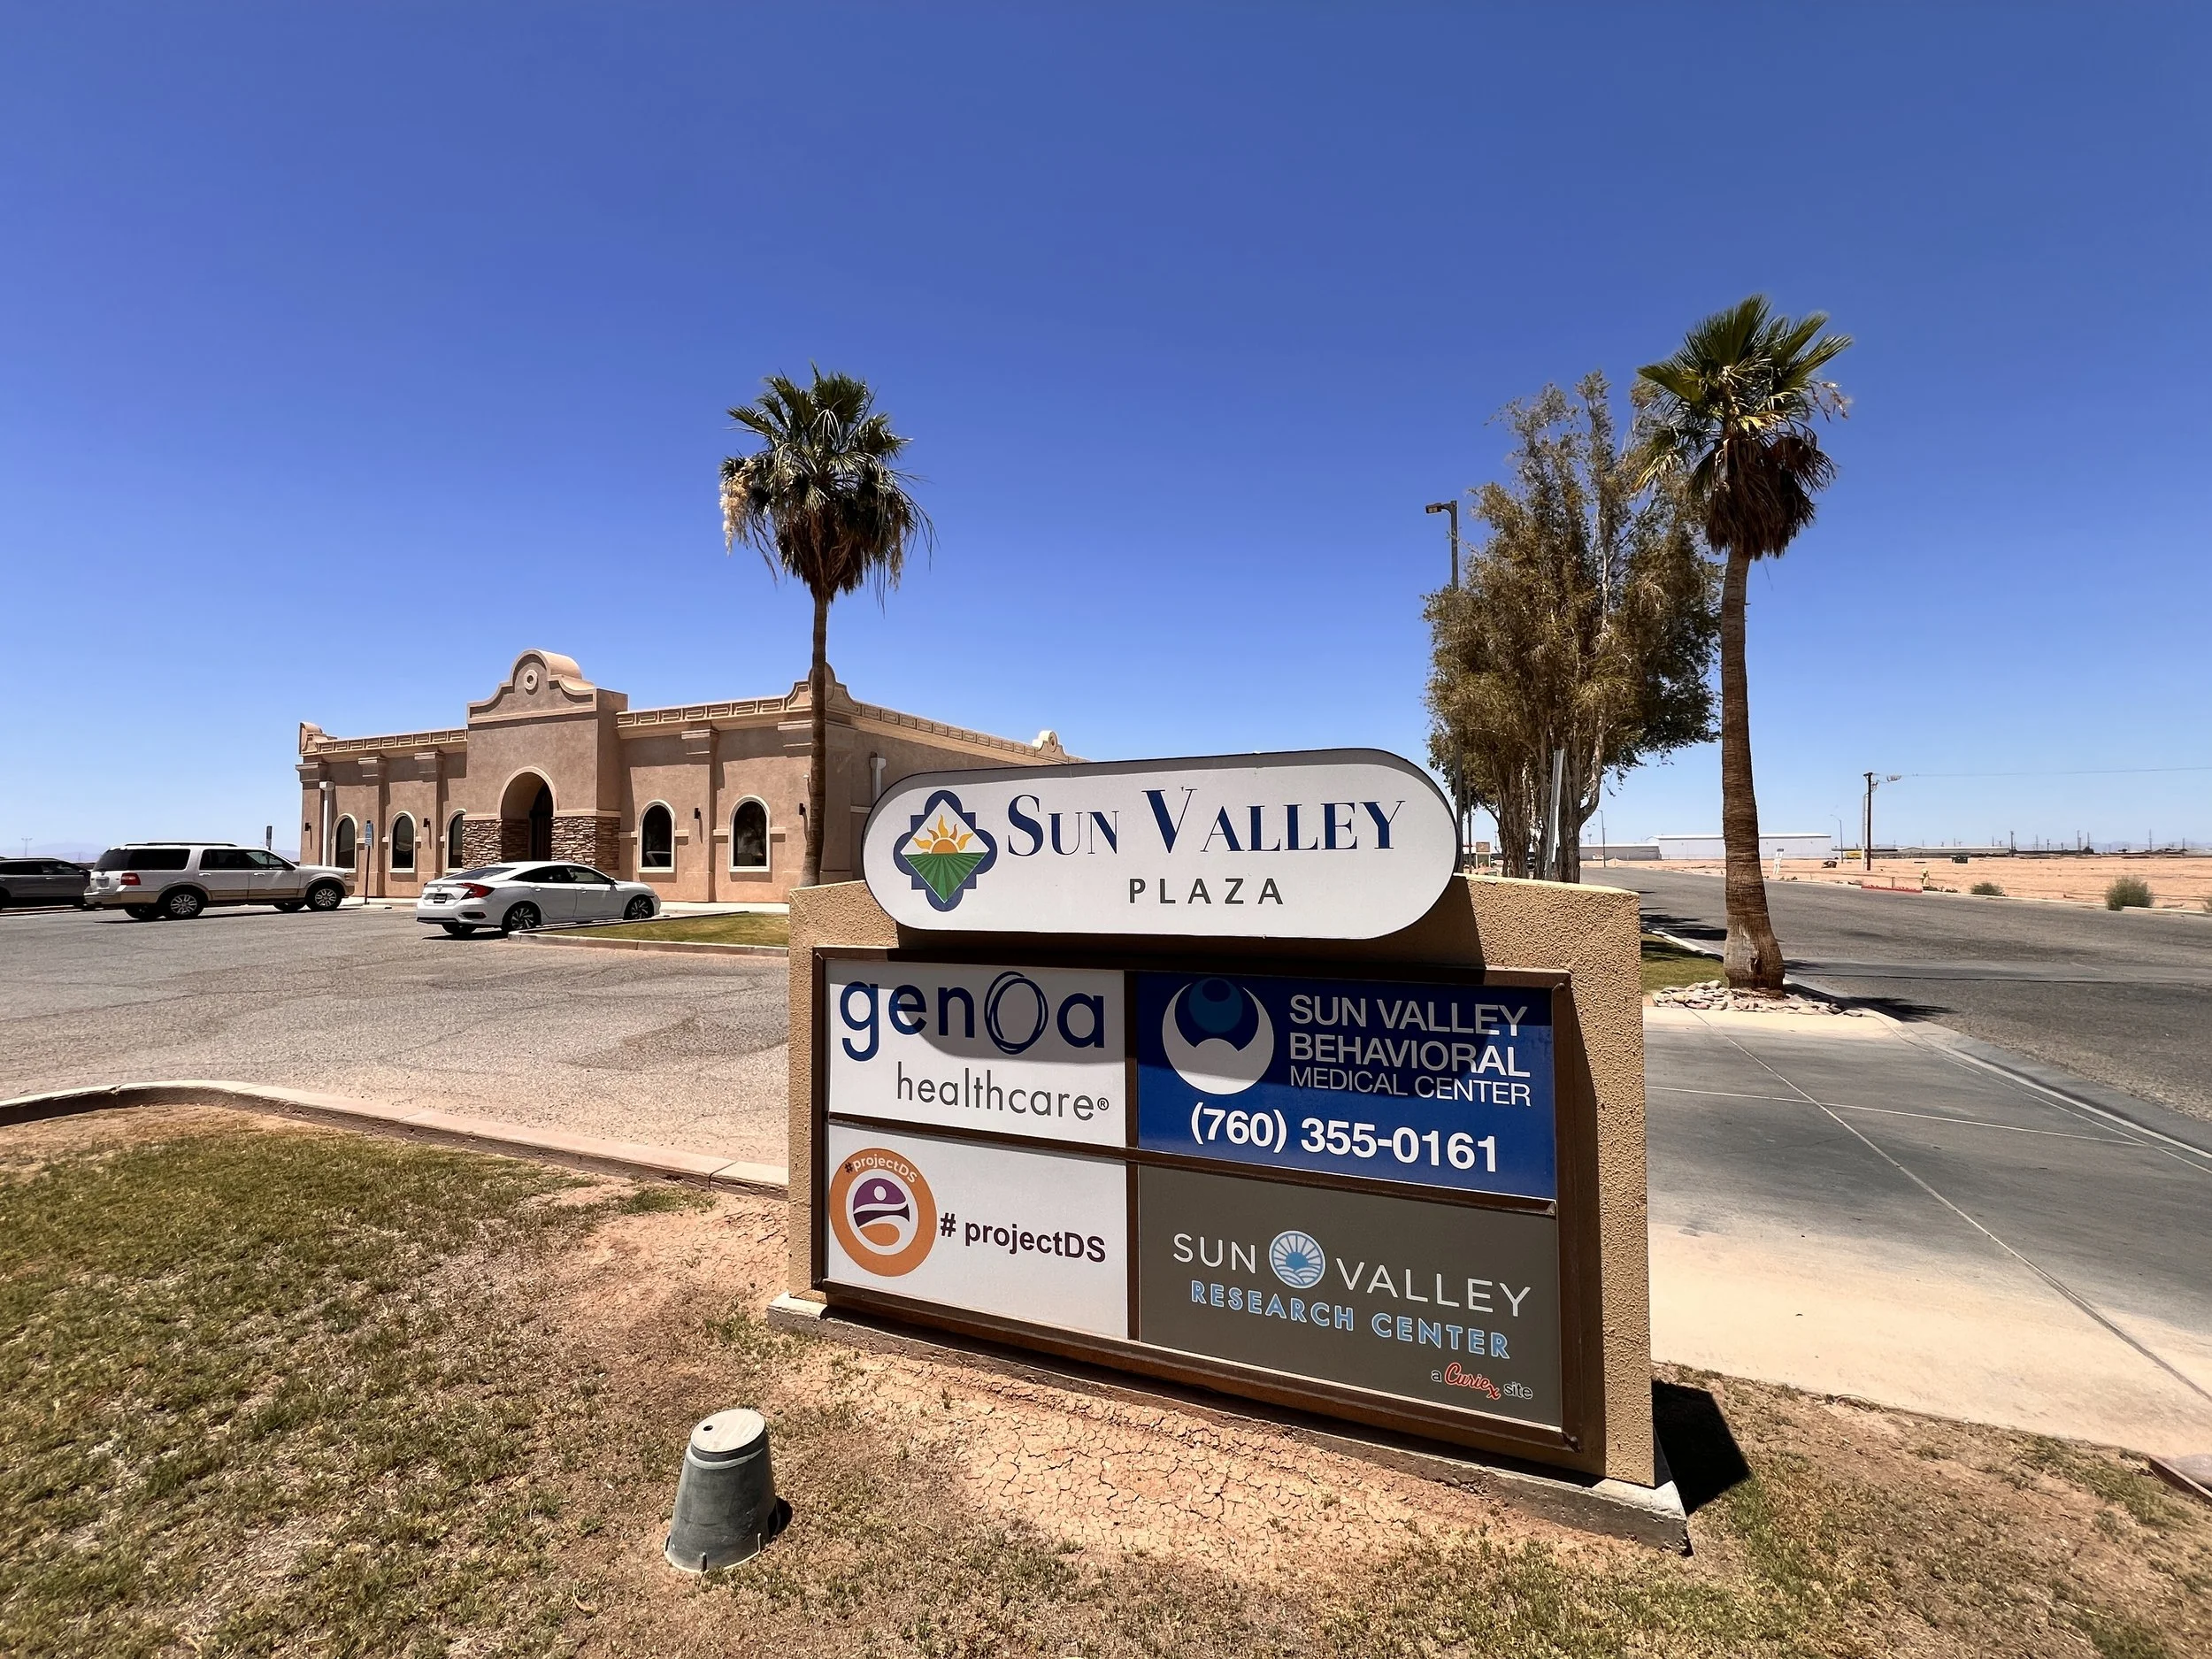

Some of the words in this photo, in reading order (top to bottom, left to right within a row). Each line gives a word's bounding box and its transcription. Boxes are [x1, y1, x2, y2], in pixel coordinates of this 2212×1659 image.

[1128, 877, 1284, 904] PLAZA
[1289, 995, 1366, 1027] SUN
[1376, 999, 1528, 1036] VALLEY
[1289, 1032, 1531, 1078] BEHAVIORAL
[1290, 1065, 1409, 1096] MEDICAL
[1414, 1075, 1532, 1107] CENTER
[1190, 1102, 1287, 1154] (760)
[1300, 1117, 1497, 1173] 355-0161
[843, 1153, 919, 1185] #projectDS
[964, 1221, 1107, 1263] projectDS
[1172, 1233, 1256, 1274] SUN
[1335, 1257, 1532, 1317] VALLEY
[1191, 1279, 1354, 1331] RESEARCH
[1371, 1312, 1510, 1359] CENTER
[1431, 1370, 1442, 1383] a
[1503, 1381, 1533, 1400] site
